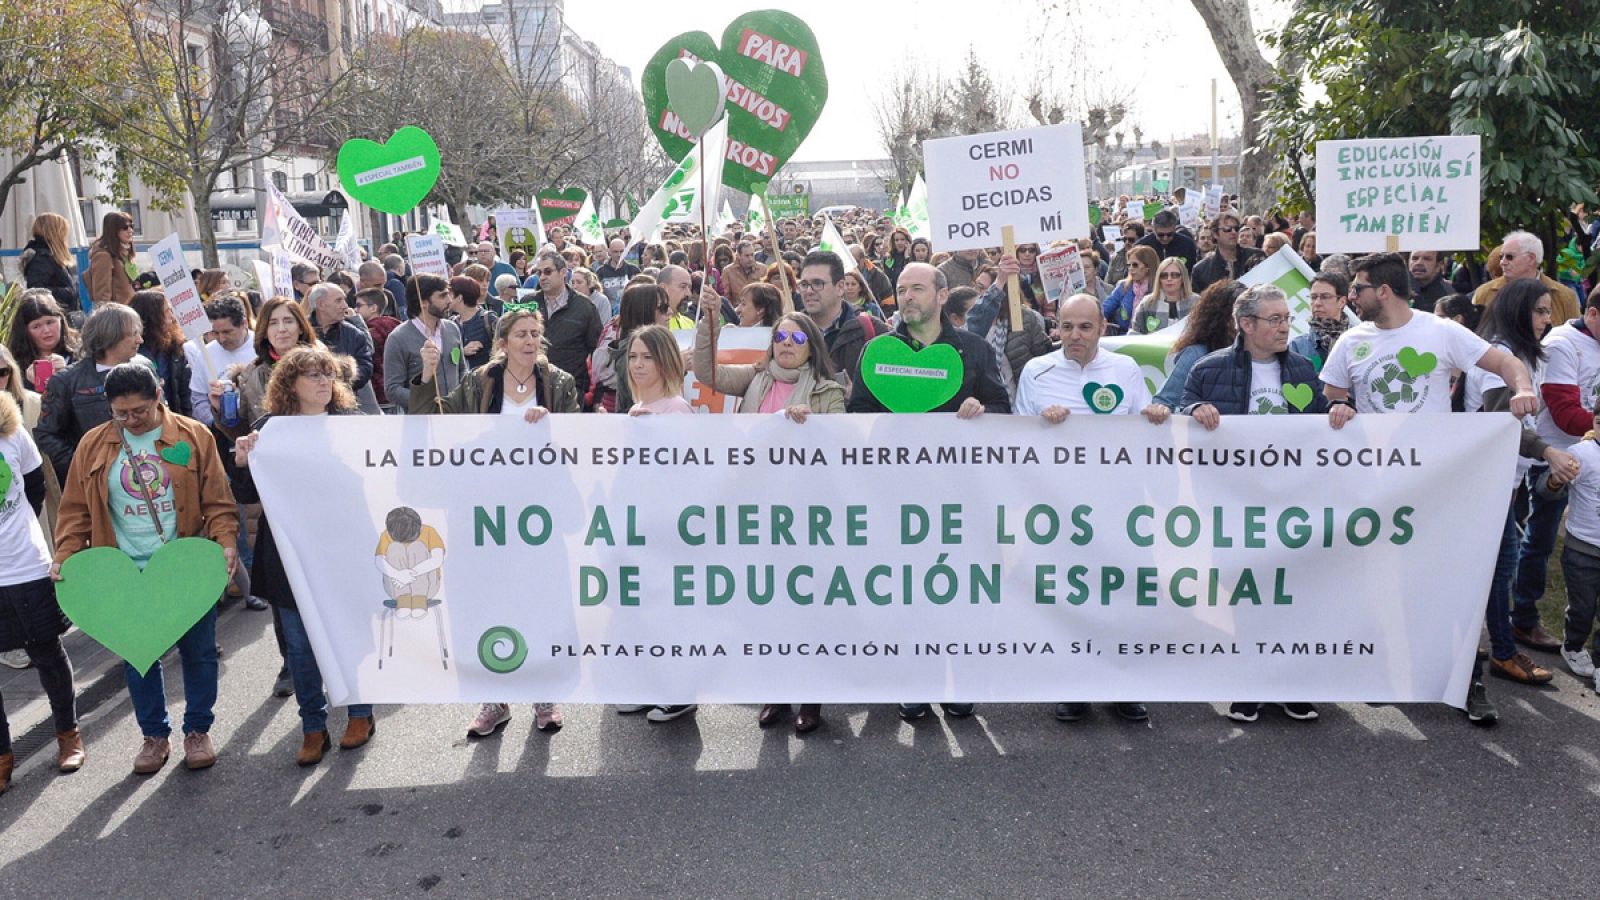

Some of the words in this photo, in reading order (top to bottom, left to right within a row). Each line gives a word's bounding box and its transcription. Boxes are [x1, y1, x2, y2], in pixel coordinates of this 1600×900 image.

[743, 34, 801, 77] PARA
[724, 74, 788, 131] USIVOS
[968, 138, 1033, 160] CERMI
[1338, 139, 1442, 164] EDUCACIÓN
[364, 170, 392, 182] ESPECIAL
[990, 163, 1019, 181] NO
[1337, 160, 1442, 181] INCLUSIVA
[1446, 152, 1475, 179] SÍ
[962, 186, 1053, 211] DECIDAS
[1347, 182, 1448, 208] ESPECIAL
[948, 221, 990, 239] POR
[1040, 211, 1062, 232] MÍ
[1340, 206, 1450, 235] TAMBIÉN
[884, 365, 912, 374] ESPECIAL
[915, 367, 945, 377] TAMBIÉN
[366, 449, 397, 467] LA
[413, 443, 578, 467] EDUCACIÓN
[592, 448, 714, 466] ESPECIAL
[728, 448, 755, 466] ES
[769, 447, 827, 466] UNA
[842, 447, 1039, 466] HERRAMIENTA
[1055, 447, 1086, 465] DE
[1101, 447, 1132, 465] LA
[1147, 443, 1302, 467] INCLUSIÓN
[1317, 448, 1421, 467] SOCIAL
[473, 505, 553, 547] NO
[584, 505, 646, 547] AL
[677, 504, 868, 546] CIERRE
[900, 503, 962, 545] DE
[996, 503, 1094, 546] LOS
[1126, 504, 1415, 550] COLEGIOS
[579, 566, 641, 607] DE
[673, 552, 1001, 607] EDUCACIÓN
[1035, 564, 1293, 609] ESPECIAL
[551, 643, 727, 657] PLATAFORMA
[743, 640, 899, 656] EDUCACIÓN
[915, 642, 1055, 656] INCLUSIVA
[1071, 639, 1101, 657] SÍ,
[1118, 642, 1241, 656] ESPECIAL
[1256, 639, 1376, 656] TAMBIÉN
